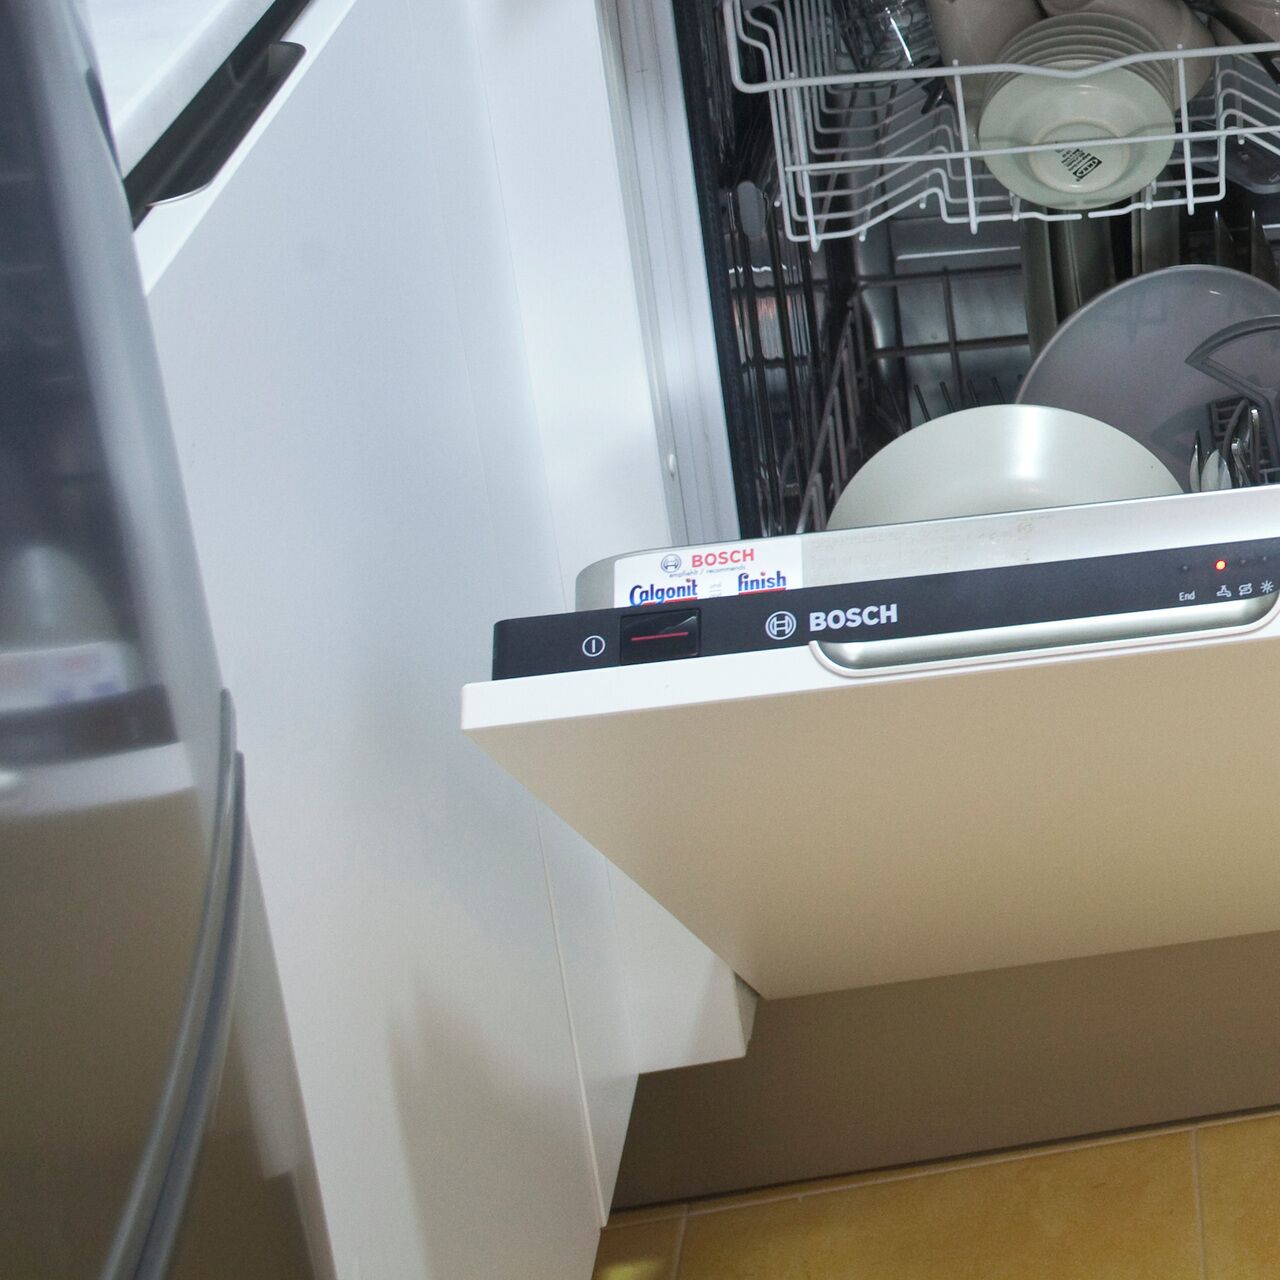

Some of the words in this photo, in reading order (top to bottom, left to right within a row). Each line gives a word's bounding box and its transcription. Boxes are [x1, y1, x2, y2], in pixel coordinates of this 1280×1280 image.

[692, 548, 755, 568] BOSCH
[629, 578, 698, 607] Calgonit
[738, 571, 787, 591] finish
[1179, 592, 1196, 601] End
[809, 604, 898, 632] BOSCH
